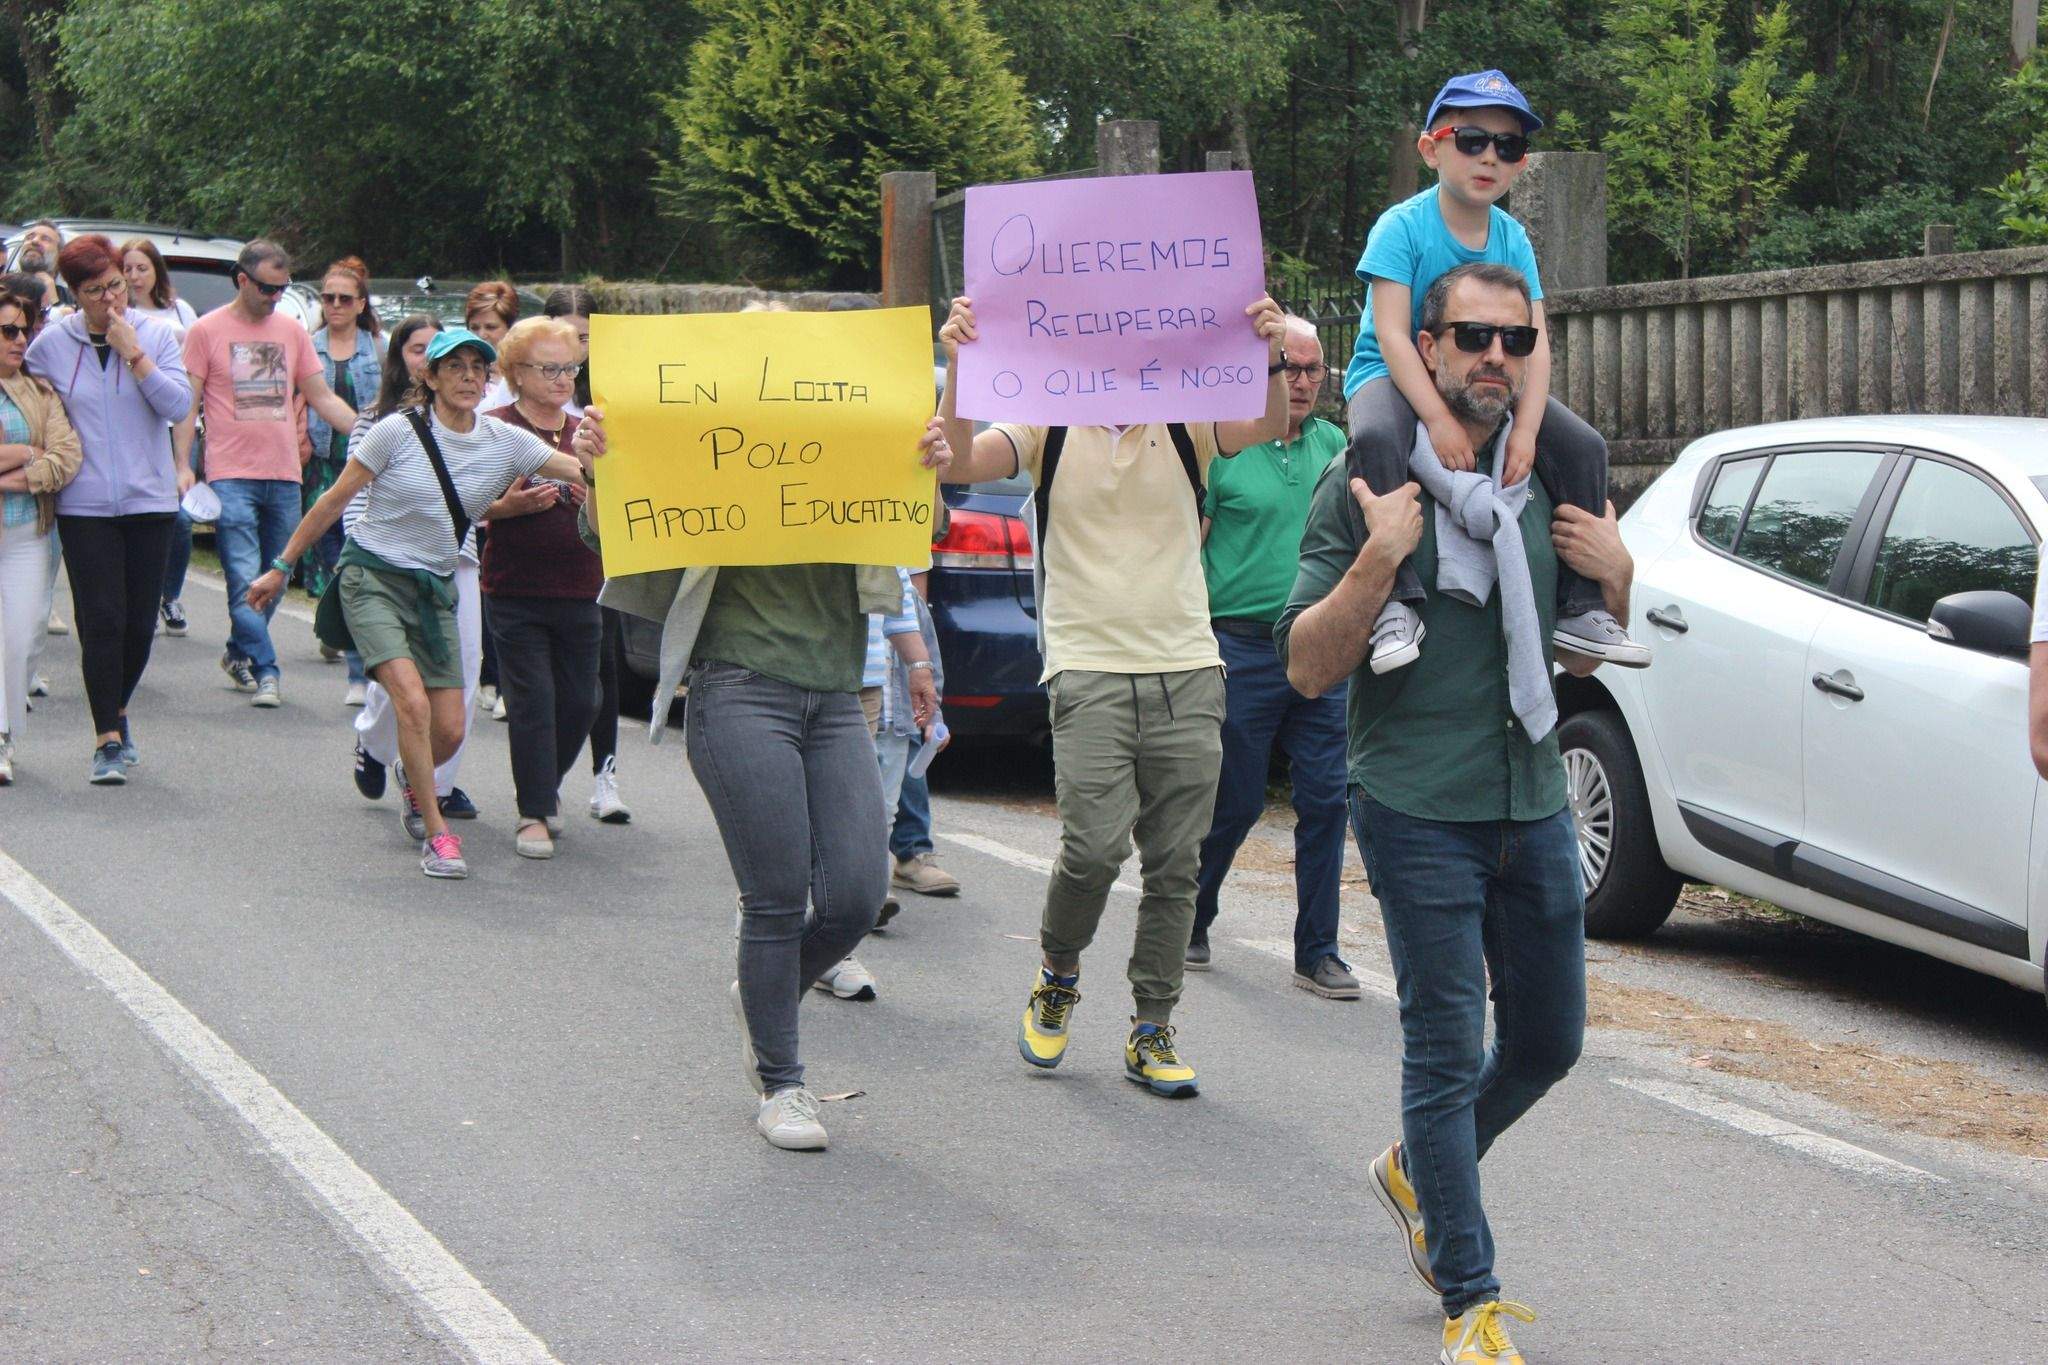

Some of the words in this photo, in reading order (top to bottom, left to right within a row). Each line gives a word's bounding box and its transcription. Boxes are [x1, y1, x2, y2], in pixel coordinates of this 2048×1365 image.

[991, 214, 1230, 276] QUEREMOS
[1026, 300, 1221, 338] RECUPERAR
[659, 363, 718, 405] EN
[759, 356, 869, 403] LOITA
[992, 370, 1022, 398] O
[1045, 368, 1116, 396] QUE
[1139, 359, 1162, 391] É
[1181, 366, 1254, 389] NOSO
[700, 427, 822, 470] POLO
[624, 498, 746, 541] APOIO
[781, 482, 930, 527] EDUCATIVO
